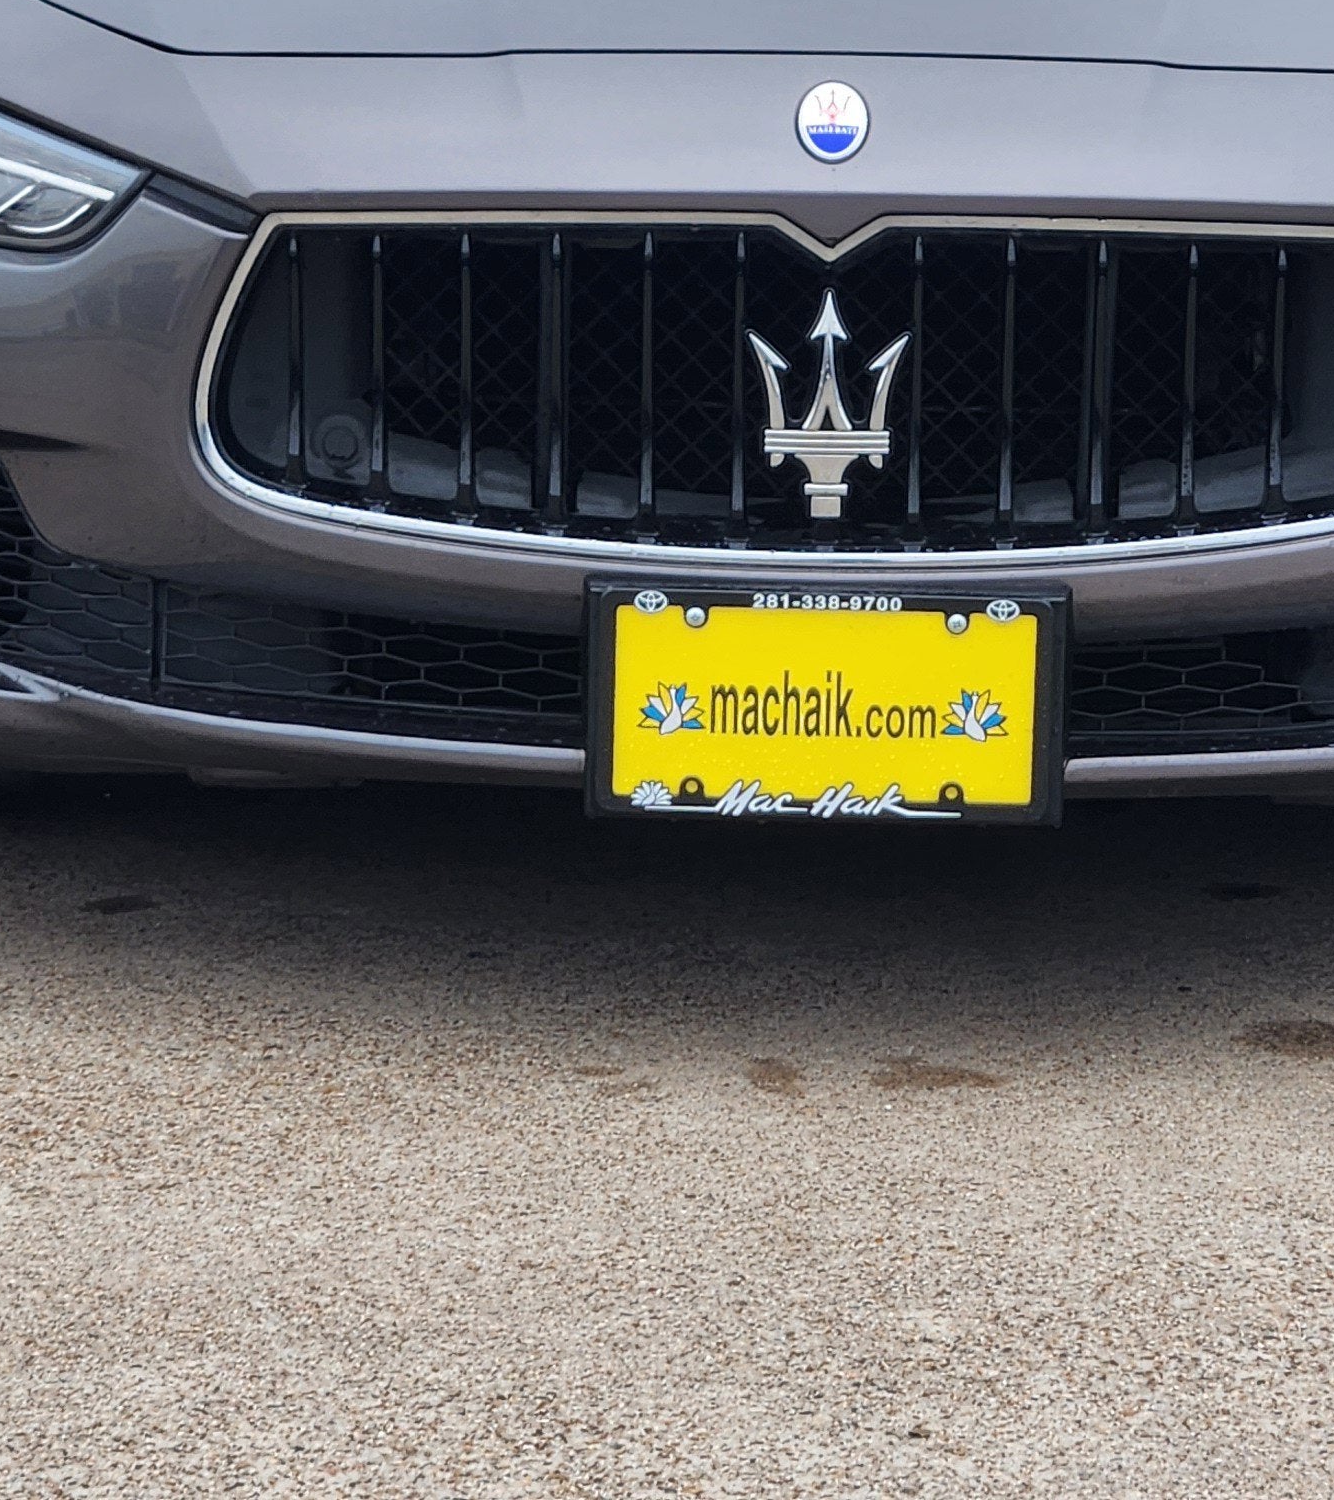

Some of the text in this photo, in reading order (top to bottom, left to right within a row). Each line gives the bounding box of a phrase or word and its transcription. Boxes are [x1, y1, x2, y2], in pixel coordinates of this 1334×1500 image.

[752, 592, 903, 612] 281-338-9700
[709, 669, 937, 739] machaik.com
[716, 779, 909, 819] Mac Haik
